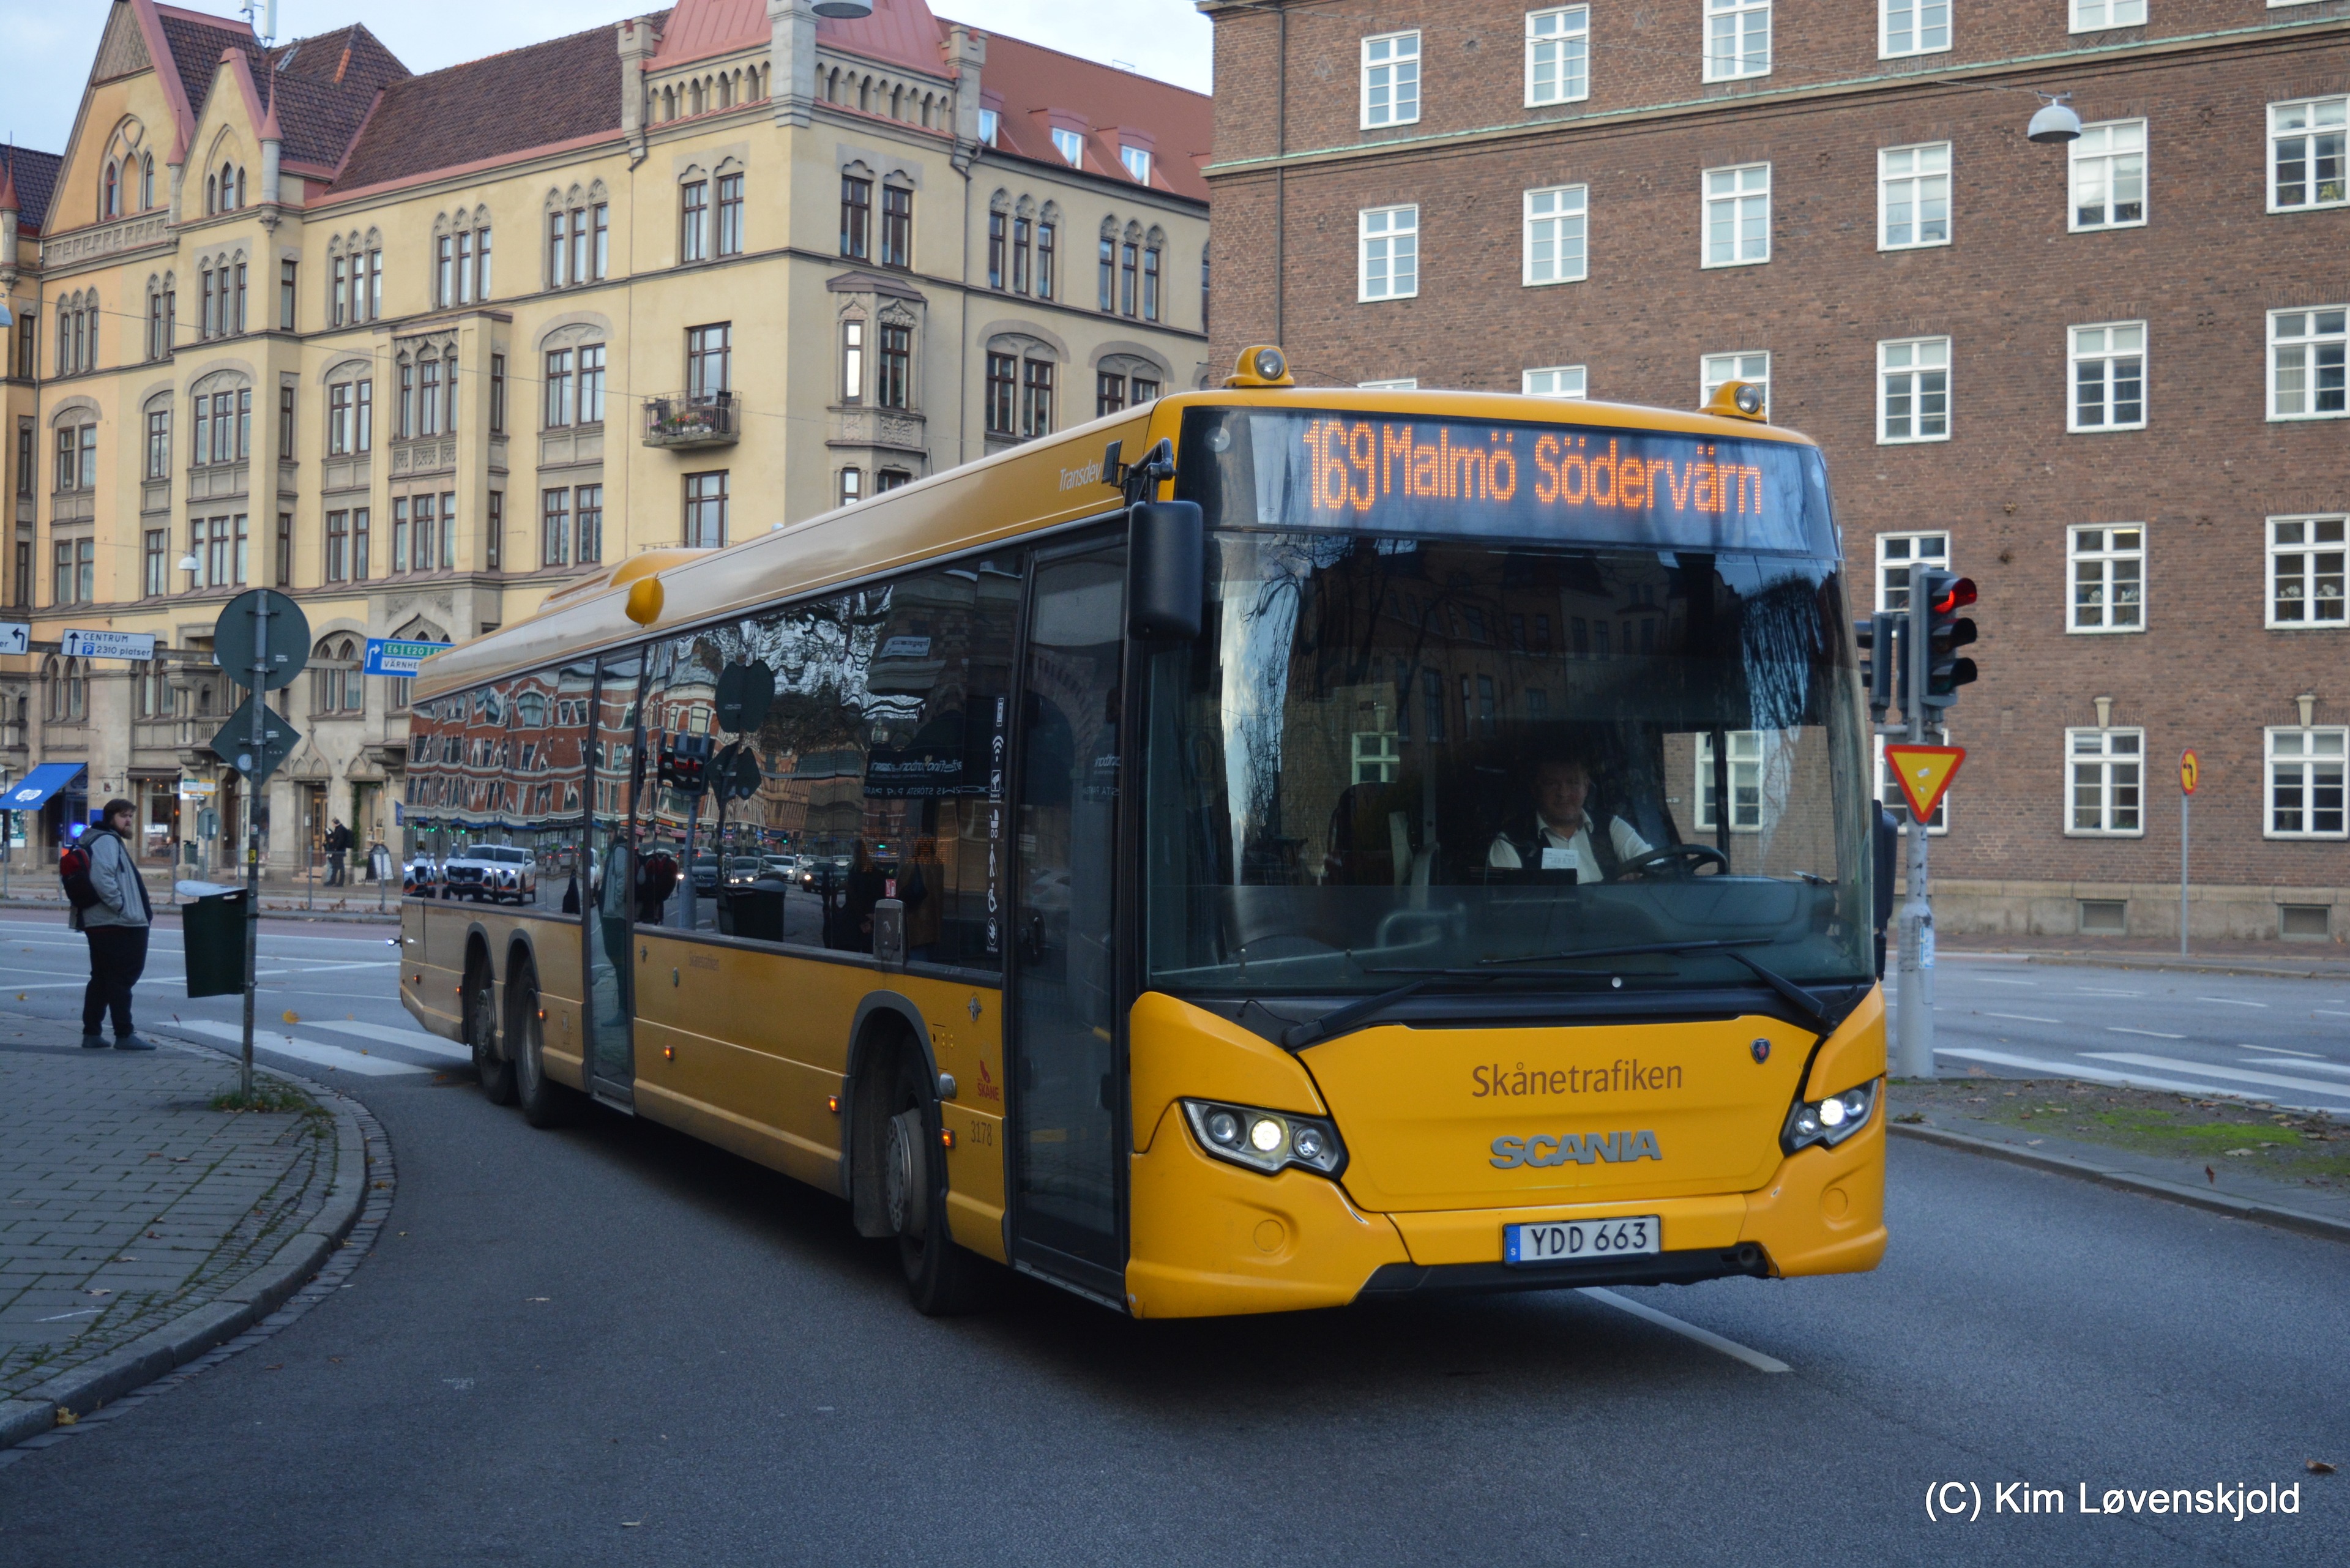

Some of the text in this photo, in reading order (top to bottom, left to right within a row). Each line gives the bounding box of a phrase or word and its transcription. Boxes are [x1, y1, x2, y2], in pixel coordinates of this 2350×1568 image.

[1059, 459, 1102, 492] Transdev
[1304, 419, 1762, 516] 169 Malmö Södervärn
[83, 633, 129, 643] CENTRUM
[97, 646, 117, 654] 2310
[119, 646, 151, 657] platser
[384, 659, 419, 670] VÄRNHE
[1471, 1058, 1682, 1097] Skånetrafiken
[971, 1120, 993, 1146] 3178
[1489, 1129, 1663, 1169] SCANIA
[1531, 1222, 1647, 1256] YDD 663
